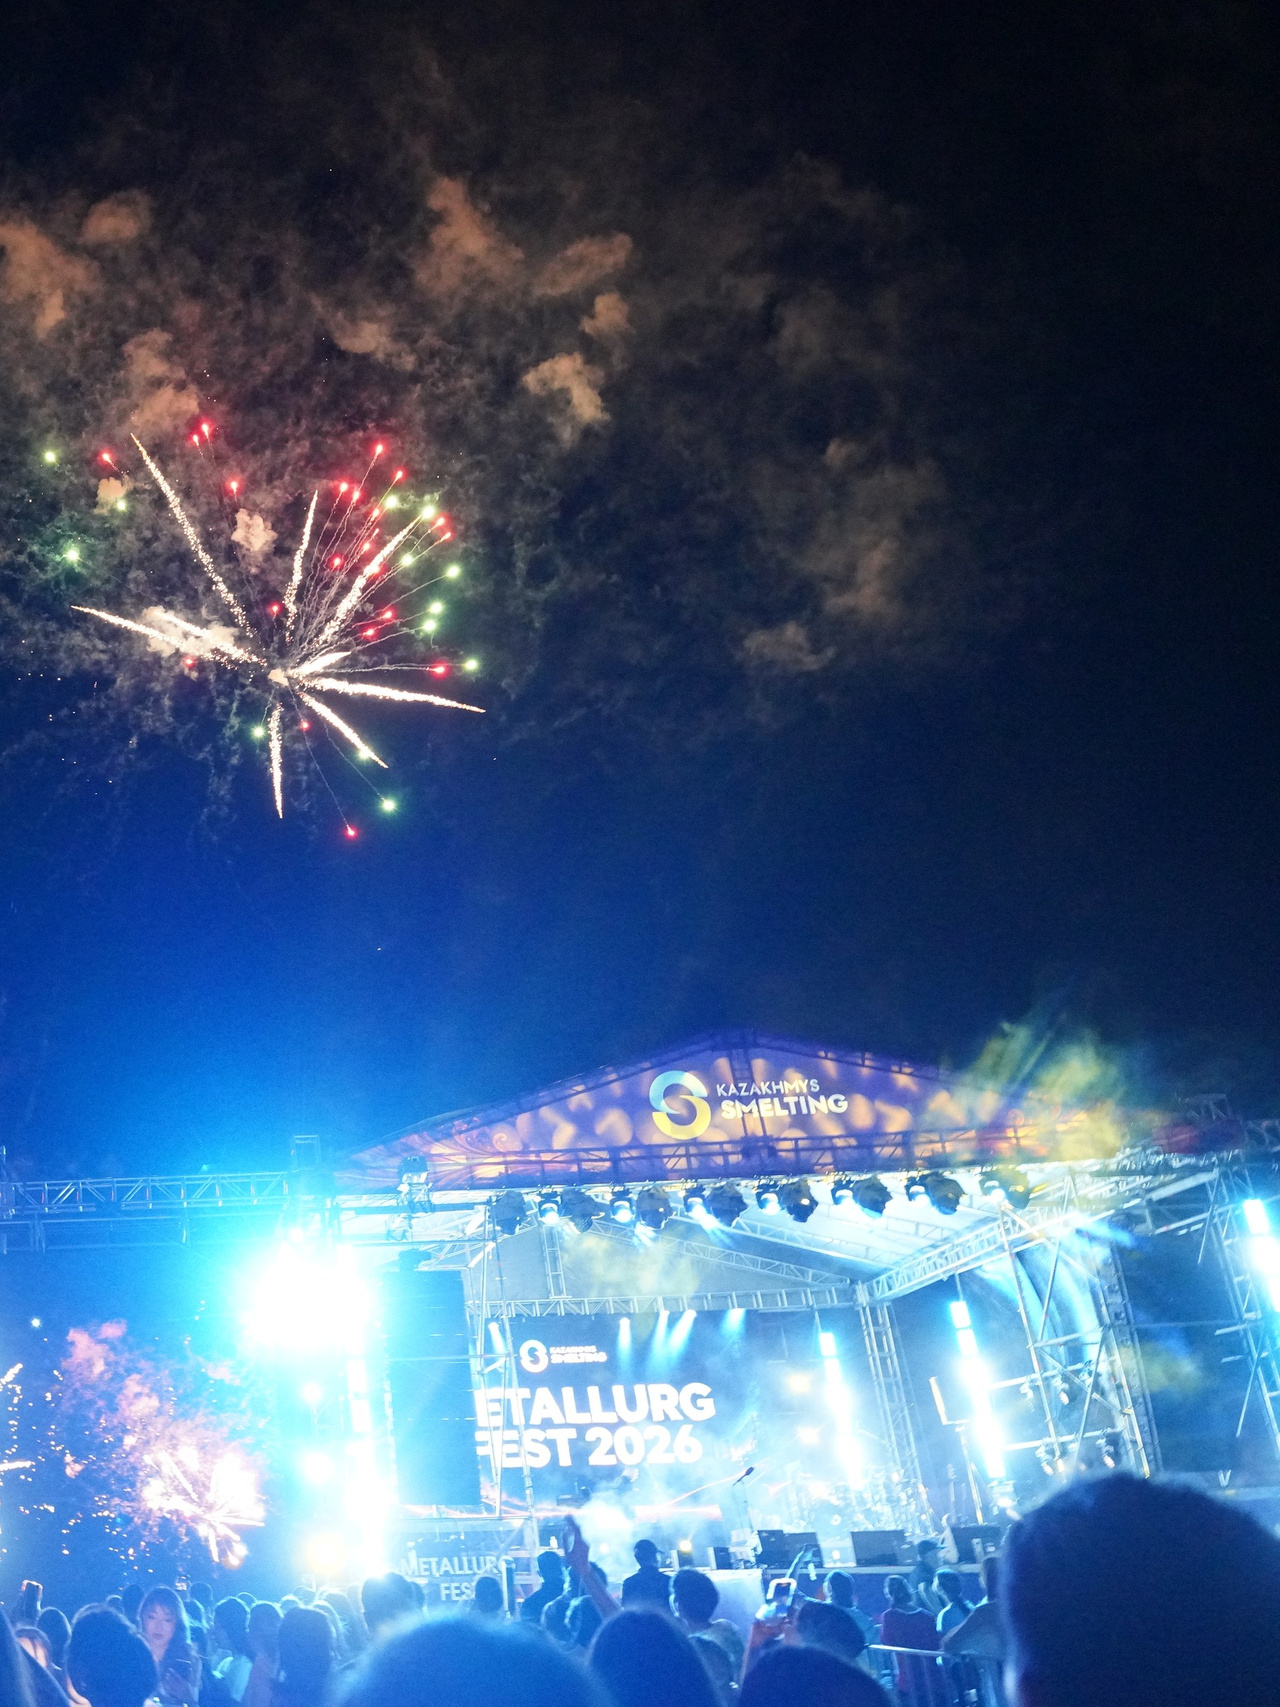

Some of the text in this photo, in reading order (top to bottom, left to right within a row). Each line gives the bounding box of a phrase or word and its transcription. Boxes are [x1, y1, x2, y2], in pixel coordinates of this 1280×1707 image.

[716, 1078, 820, 1097] KAZAKHMYS
[721, 1094, 848, 1119] SMELTING
[474, 1382, 716, 1427] ETALLURG
[585, 1424, 703, 1466] 2026
[440, 1582, 476, 1601] FES
